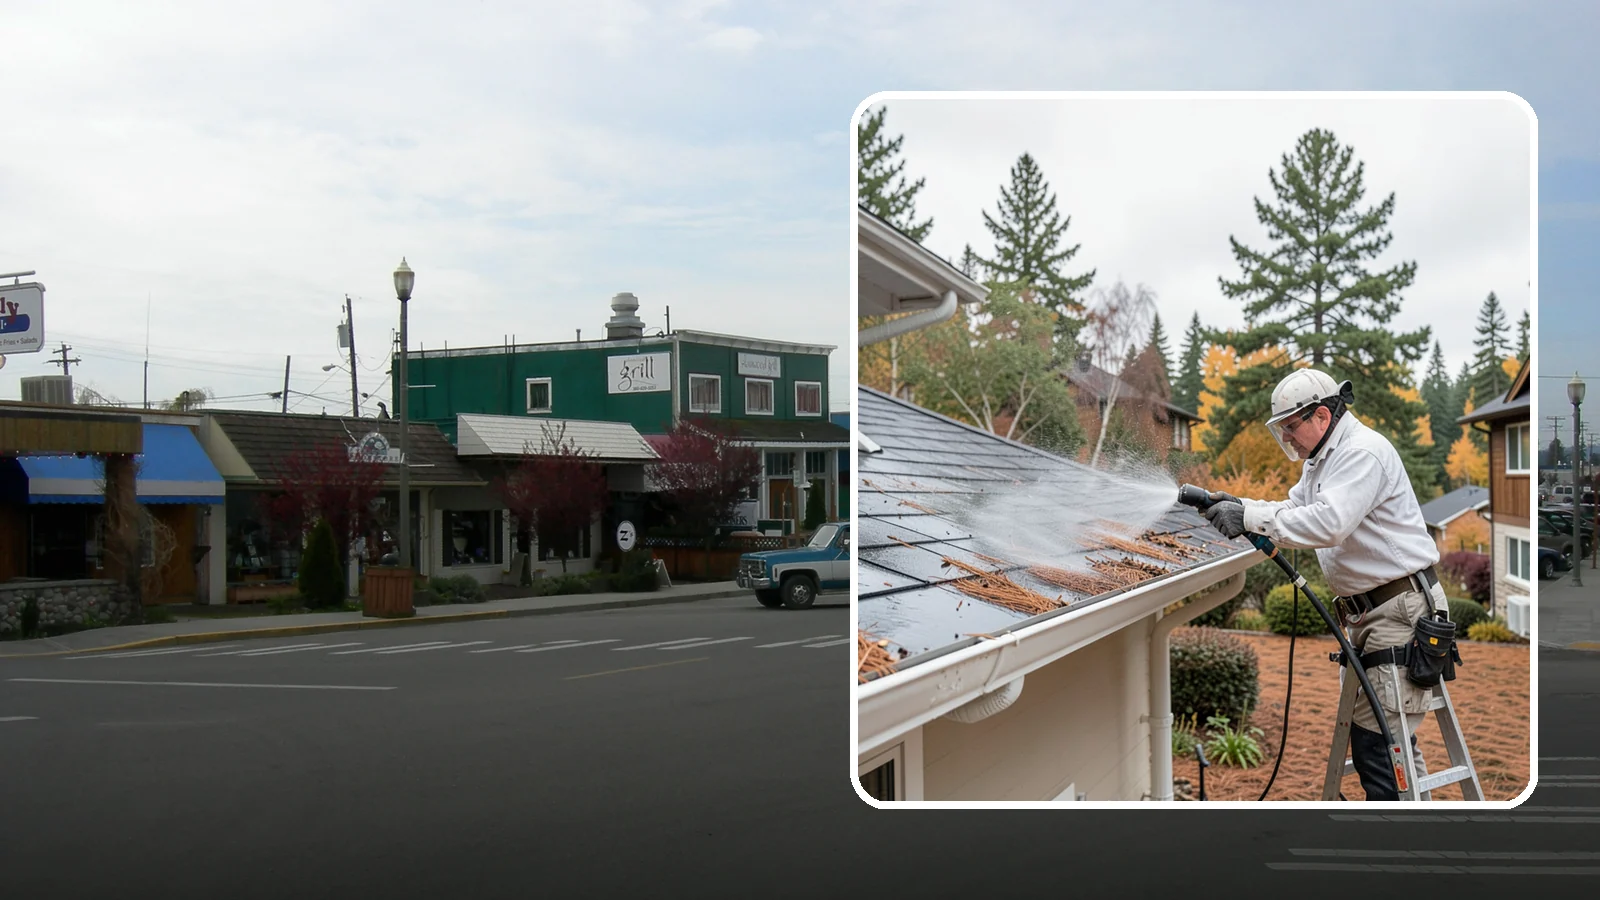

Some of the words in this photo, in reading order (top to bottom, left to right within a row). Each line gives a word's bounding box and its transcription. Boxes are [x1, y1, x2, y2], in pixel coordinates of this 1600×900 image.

[3, 338, 16, 346] Fries
[20, 337, 38, 345] Salads
[618, 356, 654, 391] grill
